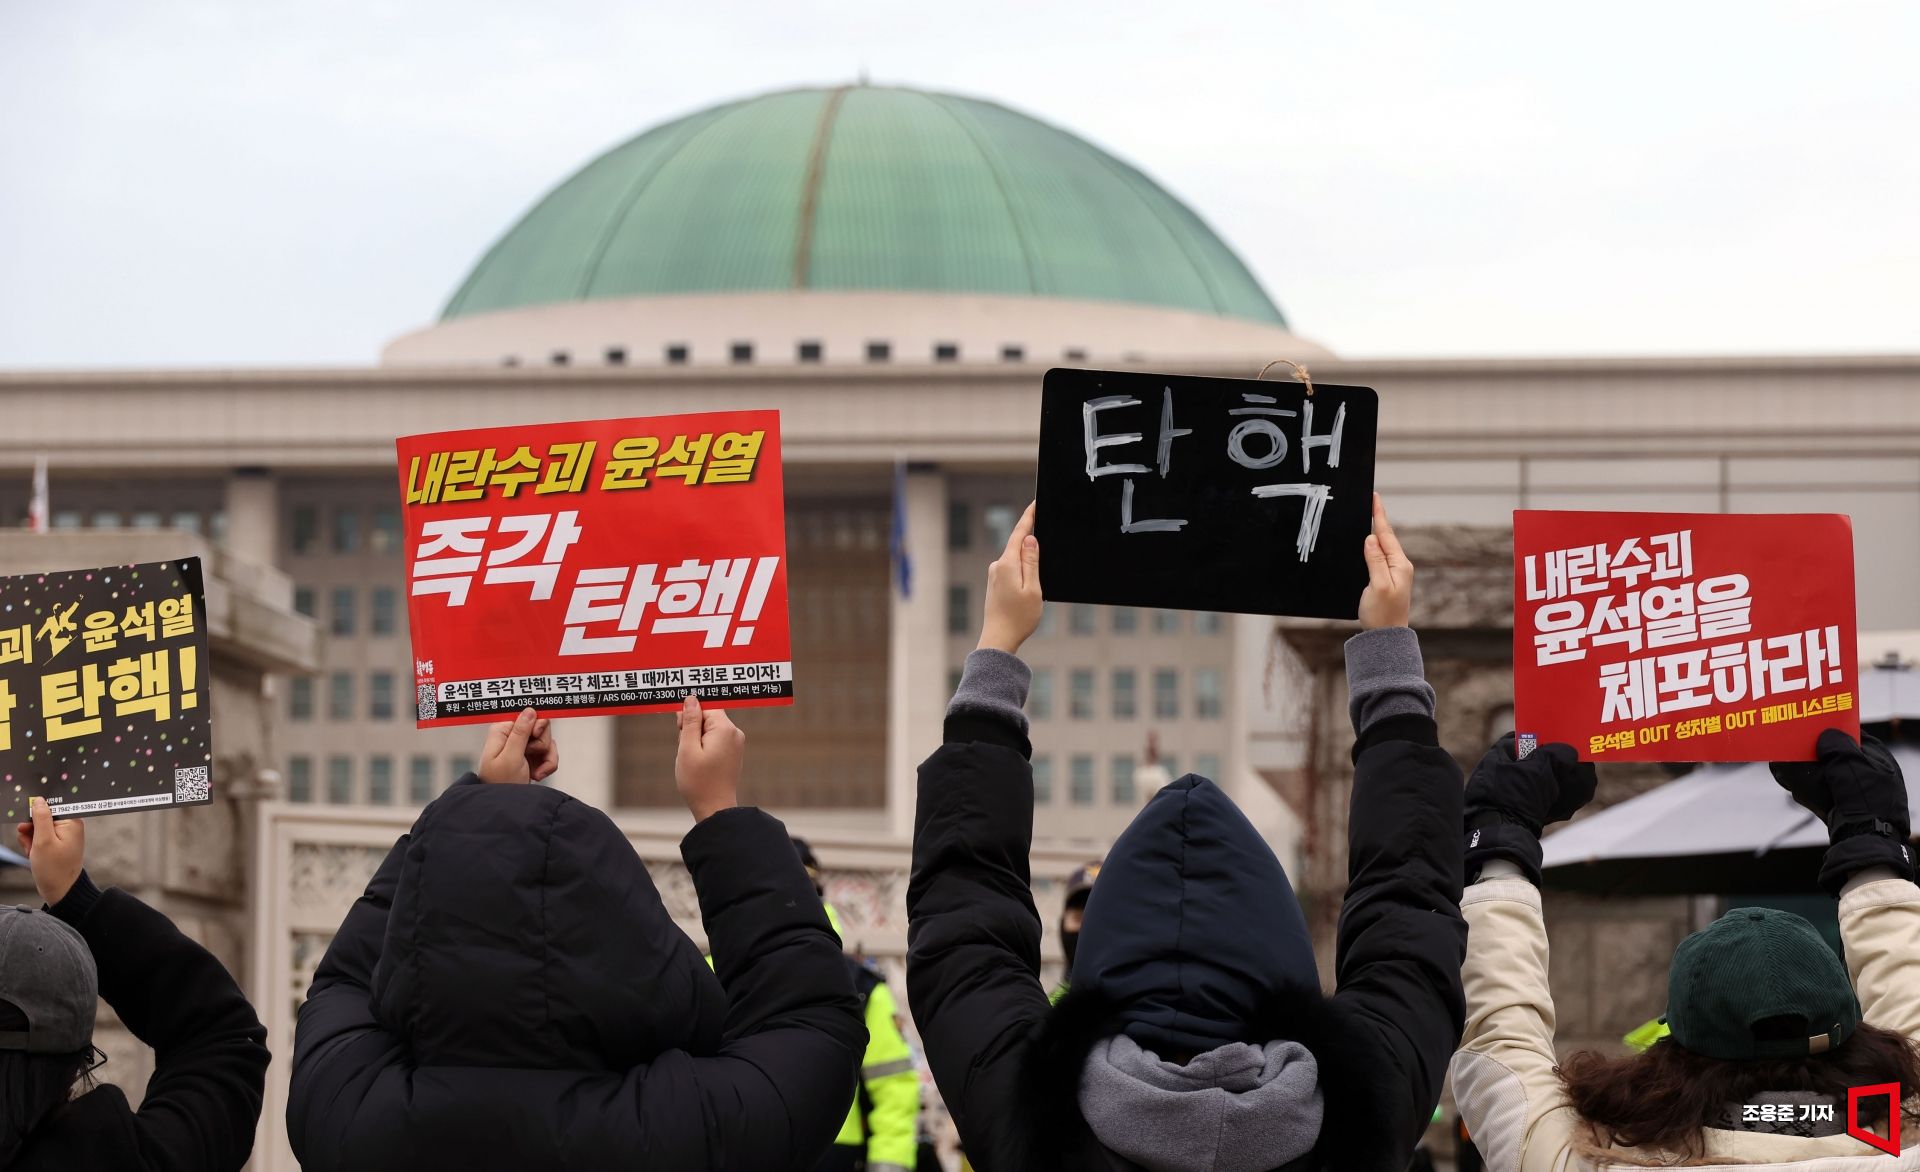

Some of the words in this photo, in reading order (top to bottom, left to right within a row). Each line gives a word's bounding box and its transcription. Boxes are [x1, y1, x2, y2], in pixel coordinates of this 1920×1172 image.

[406, 441, 597, 504] 내란수괴
[600, 430, 765, 490] 윤석열
[411, 510, 583, 606] 즉각
[1524, 529, 1693, 601] 내란수괴
[82, 593, 195, 653] 윤석열
[558, 556, 780, 656] 탄핵!
[1534, 573, 1752, 667] 윤석열을
[41, 645, 198, 742] 탄핵!
[445, 682, 482, 699] 윤석열
[487, 680, 515, 696] 즉각
[519, 678, 551, 694] 탄핵!
[556, 677, 582, 692] 즉각
[587, 674, 619, 690] 체포!
[625, 672, 638, 688] 될
[642, 670, 684, 687] 때까지
[689, 668, 728, 684] 국회로
[732, 665, 781, 681] 모이자!
[446, 703, 460, 713] 후원
[467, 699, 498, 711] 신한은행
[500, 696, 563, 708] 100-036-164860
[603, 693, 619, 702] ARS
[620, 690, 675, 701] 060-707-3300
[677, 688, 688, 699] (한
[707, 687, 719, 696] 1만
[721, 686, 732, 696] 원,
[733, 685, 749, 694] 여러
[752, 684, 760, 694] 번
[762, 683, 782, 694] 가능)
[1599, 625, 1843, 724] 체포하라!
[1589, 729, 1636, 754] 윤석열
[1639, 724, 1671, 745] OUT
[1675, 714, 1721, 740] 성차별
[1725, 709, 1757, 730] OUT
[1761, 692, 1853, 725] 페미니스트들
